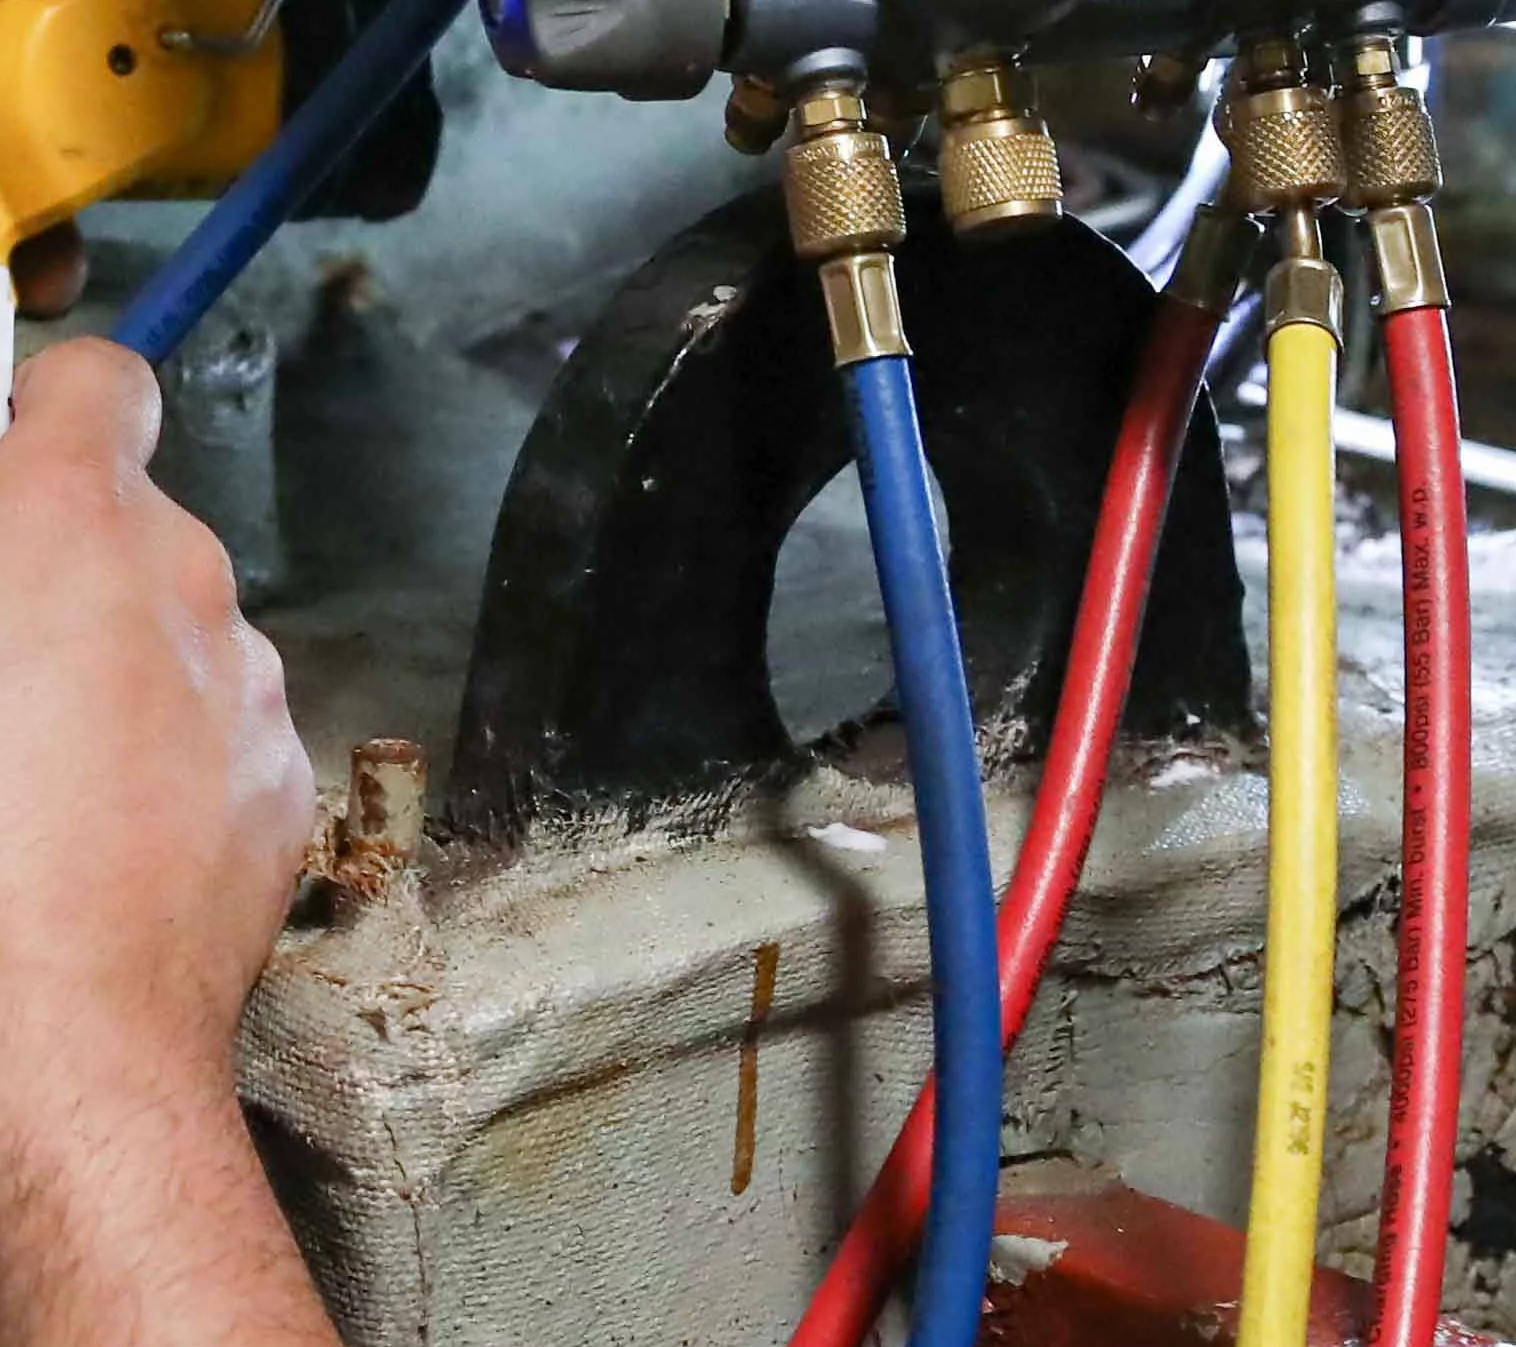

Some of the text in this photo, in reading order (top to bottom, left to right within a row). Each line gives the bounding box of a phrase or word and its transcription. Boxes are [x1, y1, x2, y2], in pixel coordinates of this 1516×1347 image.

[1413, 539, 1430, 591] Max.
[1413, 598, 1432, 644] Bar)
[1412, 693, 1433, 771] 800psi
[1408, 806, 1428, 865] burst
